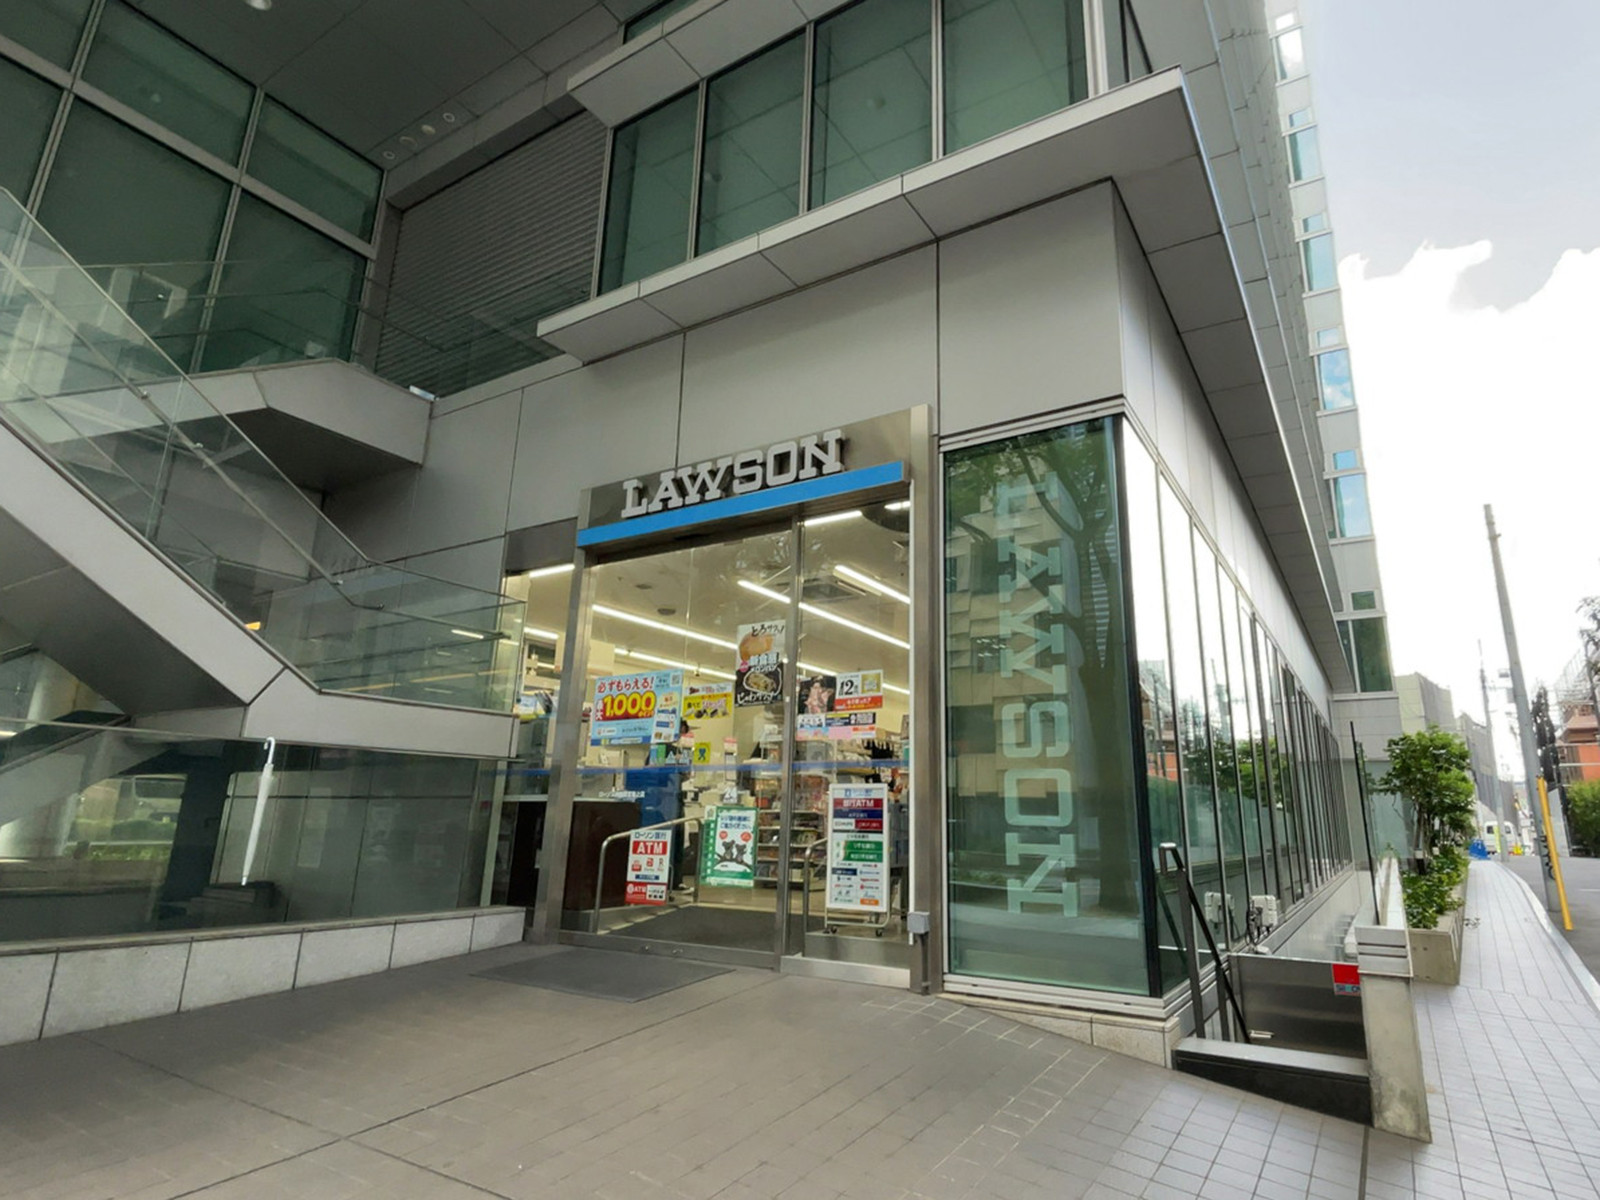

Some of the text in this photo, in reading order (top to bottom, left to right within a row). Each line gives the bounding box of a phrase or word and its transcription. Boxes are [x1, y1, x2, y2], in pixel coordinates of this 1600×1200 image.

[621, 429, 842, 519] LAWSON
[598, 676, 655, 693] 必ずもらえる!
[996, 471, 1079, 918] LAWSON
[634, 831, 666, 839] ローソン銀行
[637, 841, 663, 855] ATM
